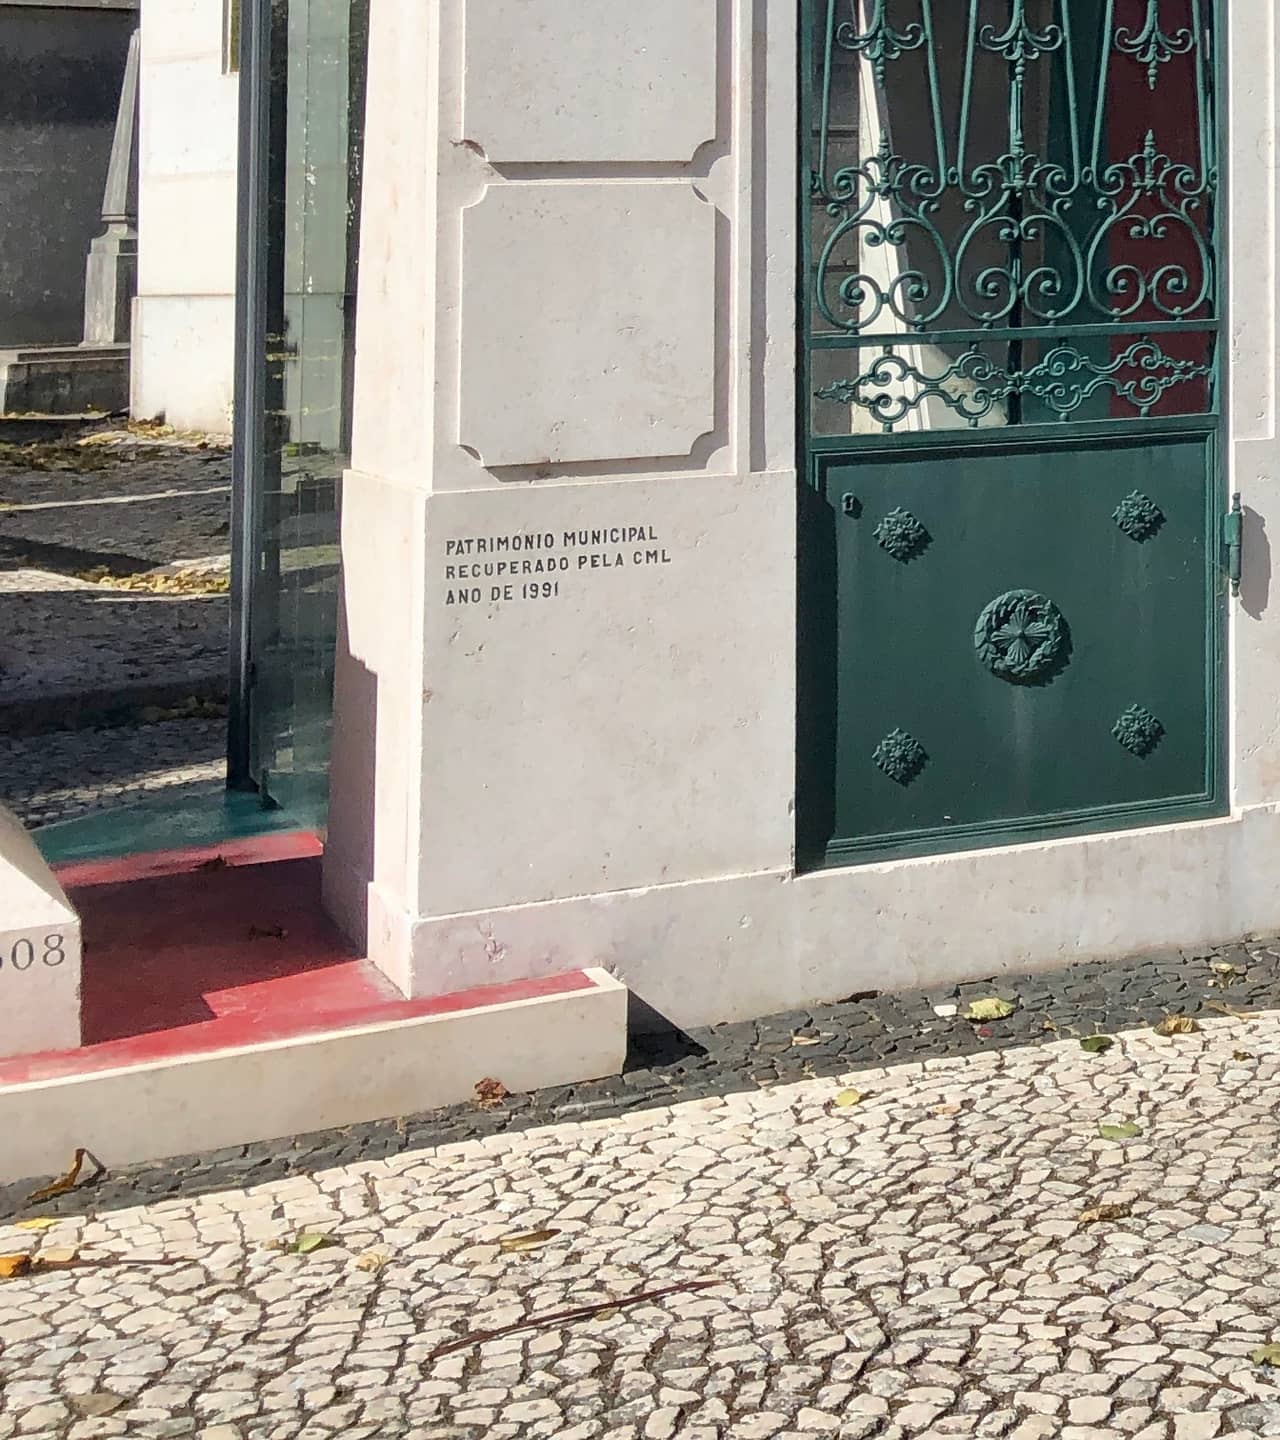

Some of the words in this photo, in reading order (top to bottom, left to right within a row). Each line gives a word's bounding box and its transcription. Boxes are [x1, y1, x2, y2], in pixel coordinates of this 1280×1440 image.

[563, 526, 658, 548] MUNICIPAL
[446, 557, 569, 579] RECUPERADO
[578, 553, 624, 569] PELA
[633, 549, 672, 565] CML
[446, 587, 481, 605] ANO
[491, 585, 514, 602] DE
[522, 581, 559, 599] 1991
[0, 934, 66, 971] 08
